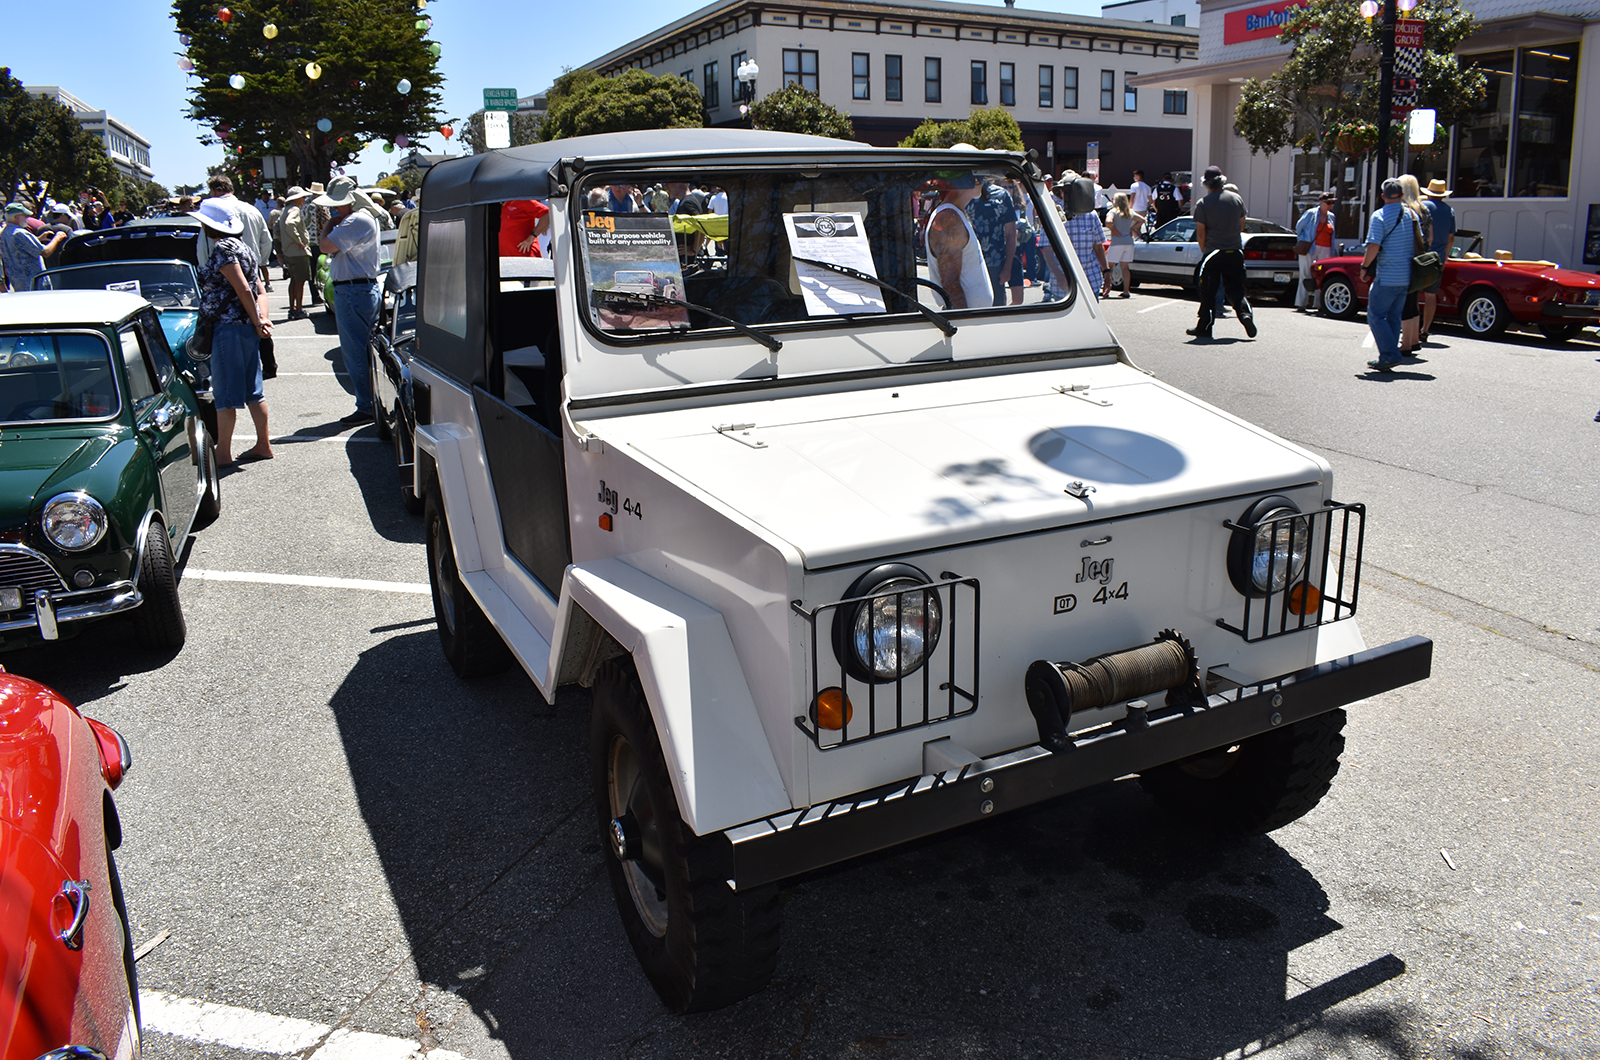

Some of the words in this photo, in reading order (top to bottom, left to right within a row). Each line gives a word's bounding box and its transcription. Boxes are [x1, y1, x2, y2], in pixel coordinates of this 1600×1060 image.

[1246, 10, 1276, 31] Bank
[1395, 23, 1422, 35] PACIFIC
[1394, 35, 1420, 46] GROVE
[586, 211, 616, 232] Jeg
[632, 238, 671, 246] eventuality
[597, 480, 618, 515] Jeg
[1075, 556, 1114, 585] Jeg
[1059, 598, 1072, 609] QT
[1092, 582, 1129, 605] 4x4
